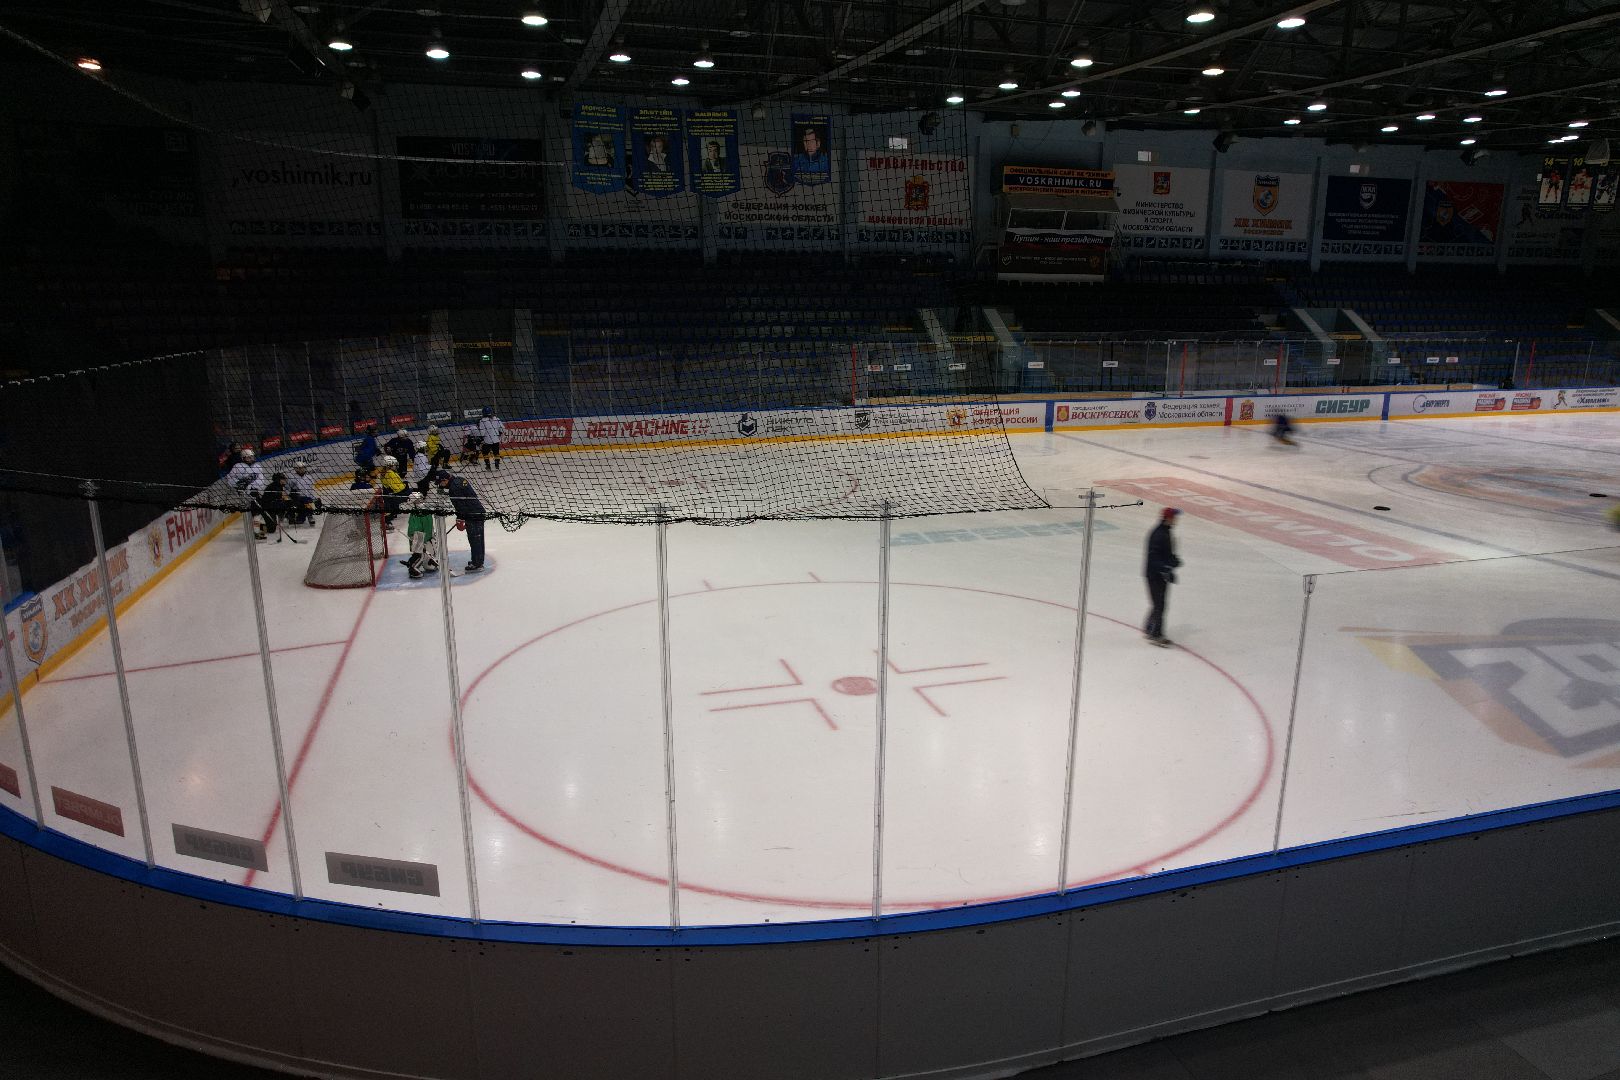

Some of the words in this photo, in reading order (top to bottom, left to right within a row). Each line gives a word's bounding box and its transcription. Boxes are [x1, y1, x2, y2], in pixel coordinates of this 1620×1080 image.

[1018, 176, 1103, 188] VOSKRHIMIK.RU
[732, 202, 789, 213] ФЕДЕРАЦИЯ
[1135, 201, 1184, 210] МИНИСТЕРСТВО
[724, 212, 790, 223] МОСКОВСКОЙ
[791, 213, 835, 224] ОБЛАСТИ
[1122, 223, 1165, 232] МОСКОВСКОЙ
[1165, 225, 1194, 233] ОБЛАСТИ
[1315, 399, 1371, 414] СИБУР
[973, 408, 1020, 417] ФЕДЕРАЦИЯ
[1071, 410, 1140, 421] ВОСКРЕСЕНСК
[1005, 416, 1038, 425] РОССИИ
[587, 420, 618, 438] RED
[623, 417, 689, 437] MACHINE
